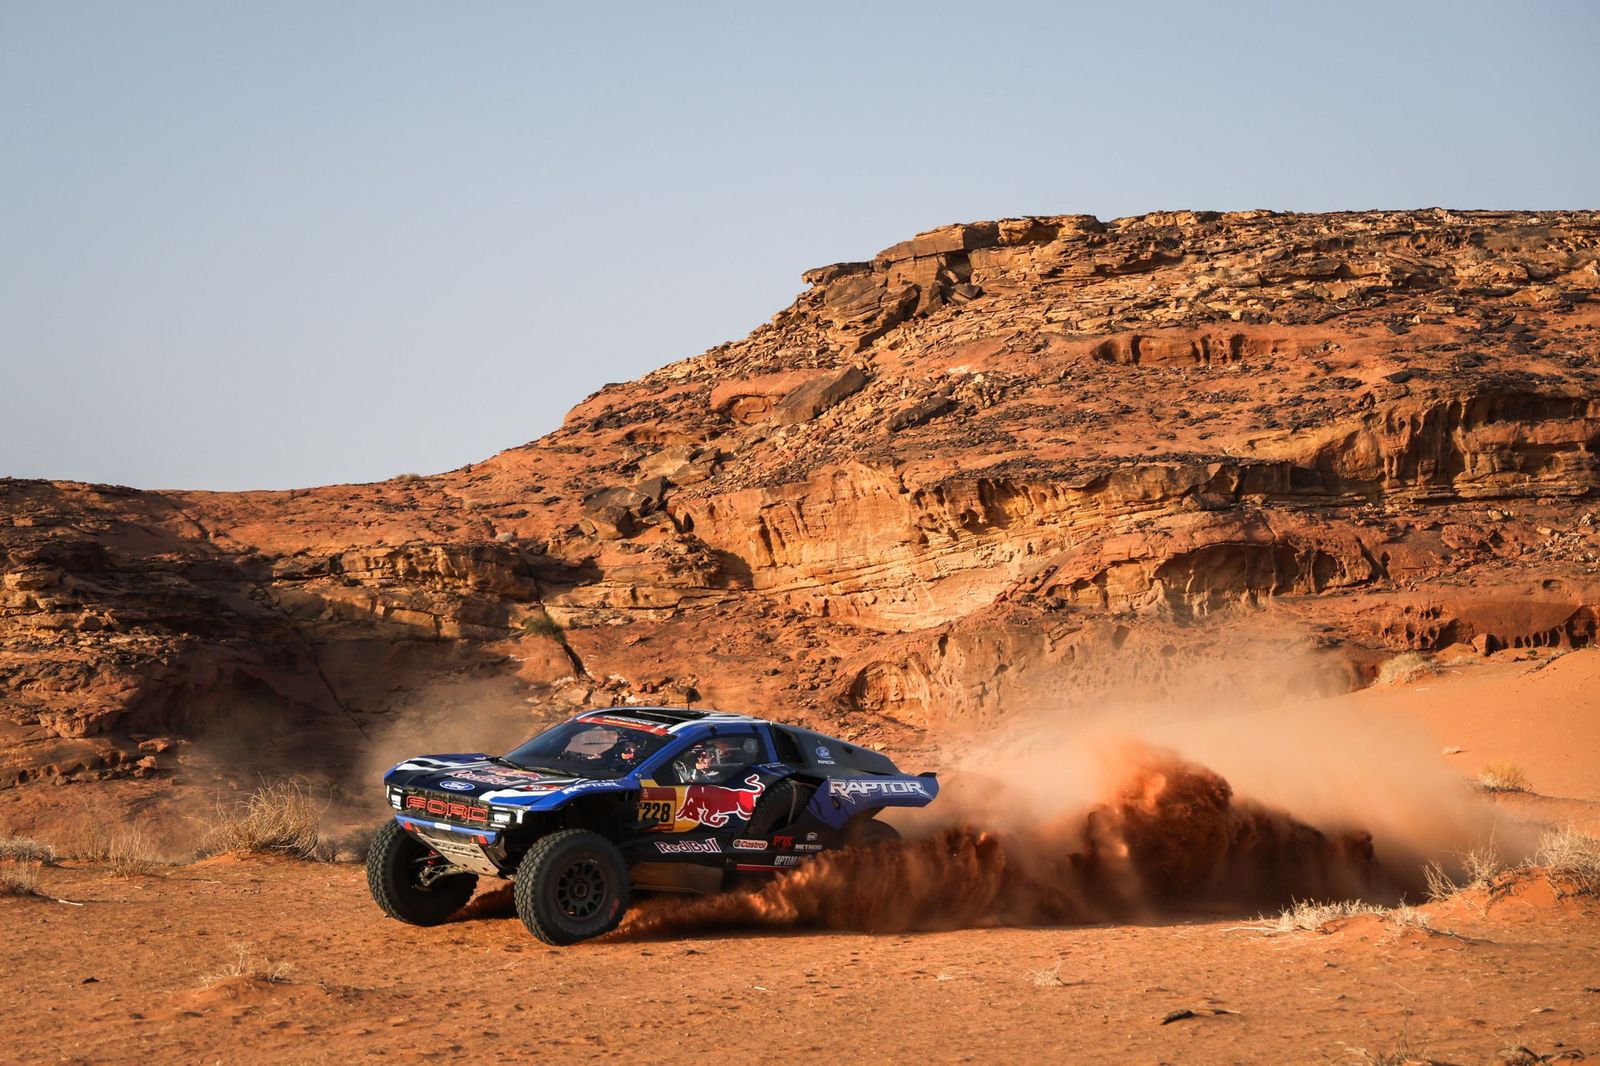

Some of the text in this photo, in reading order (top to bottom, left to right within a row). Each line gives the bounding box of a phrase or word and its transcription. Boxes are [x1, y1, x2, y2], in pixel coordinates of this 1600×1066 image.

[829, 780, 933, 804] RAPTOR
[406, 795, 488, 822] FORD
[741, 841, 767, 849] Castrol
